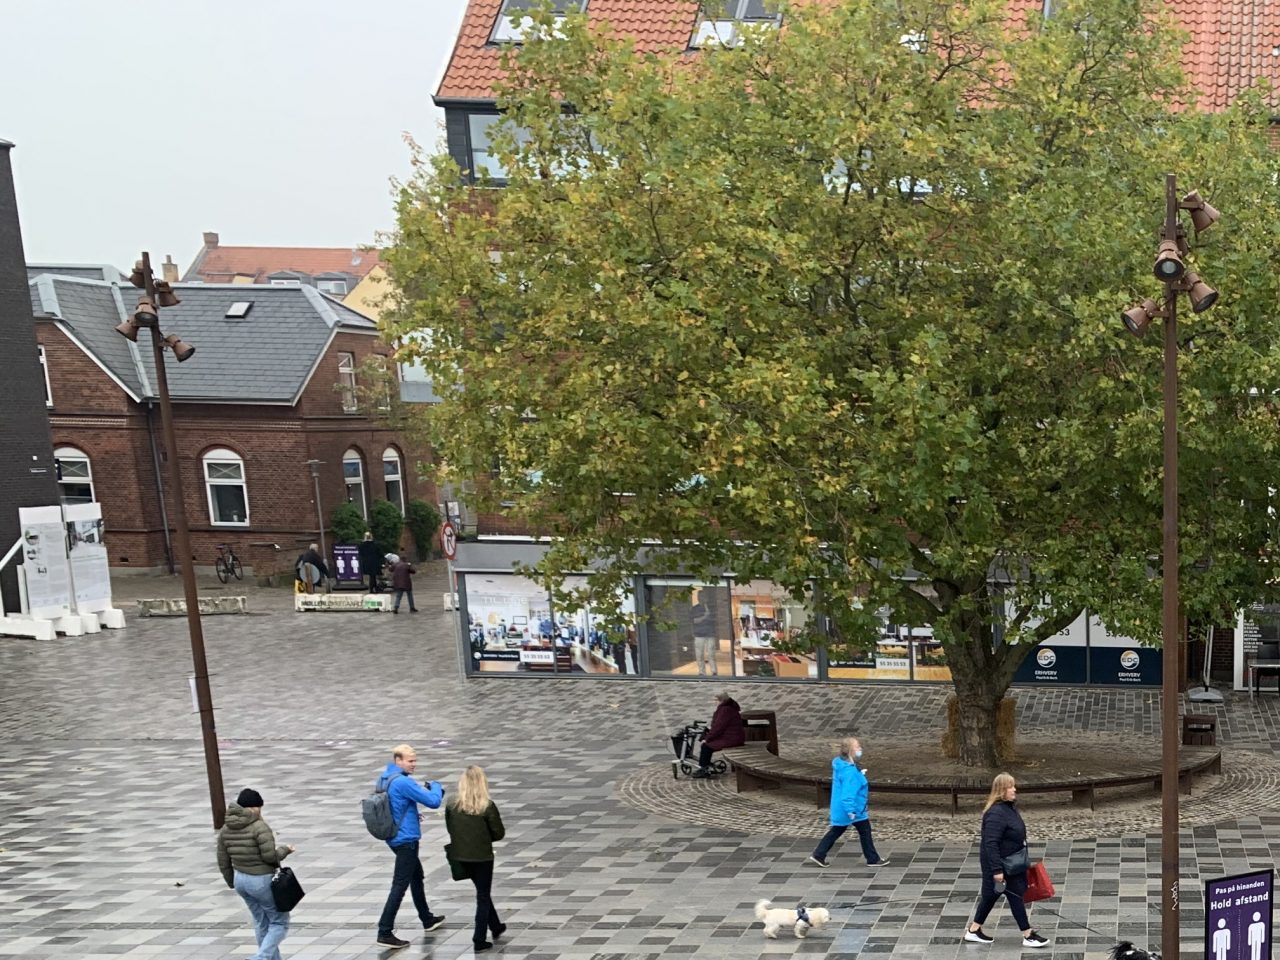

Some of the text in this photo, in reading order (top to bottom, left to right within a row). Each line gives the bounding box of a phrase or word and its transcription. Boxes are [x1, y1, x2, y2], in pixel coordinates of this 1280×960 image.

[1215, 881, 1264, 896] Pas på hinanden
[1210, 892, 1268, 911] Hold afstand
